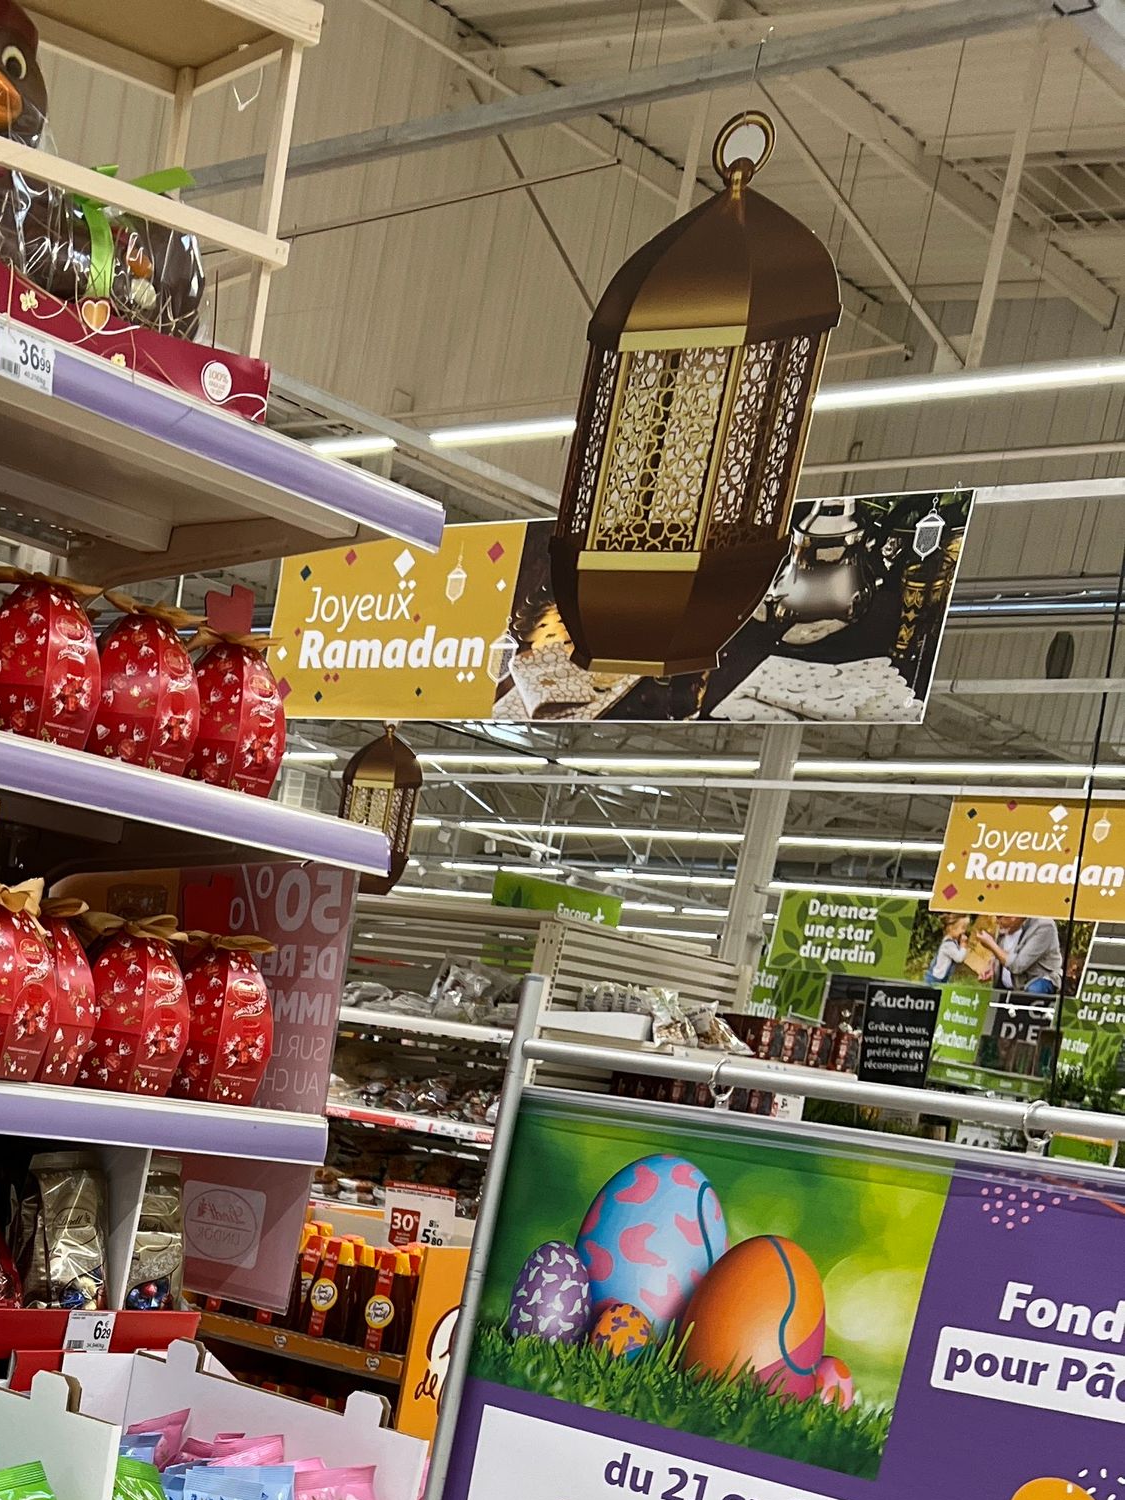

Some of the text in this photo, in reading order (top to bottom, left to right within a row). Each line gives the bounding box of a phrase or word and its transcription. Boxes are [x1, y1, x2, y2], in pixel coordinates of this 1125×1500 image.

[304, 586, 416, 626] Joyeux
[297, 625, 486, 672] Ramadan
[971, 823, 1066, 857] Joyeux
[965, 852, 1125, 888] Ramadan
[557, 903, 591, 921] Encore
[807, 898, 878, 920] Devenez
[804, 924, 874, 942] une star
[799, 943, 876, 965] du jardin
[870, 990, 935, 1011] Auchan
[1081, 991, 1111, 1005] une
[1077, 1005, 1097, 1021] du
[868, 1021, 896, 1033] Grâce
[864, 1036, 930, 1049] votre magasin
[866, 1048, 900, 1060] préféré
[943, 1347, 1049, 1386] pour
[602, 1453, 655, 1497] du
